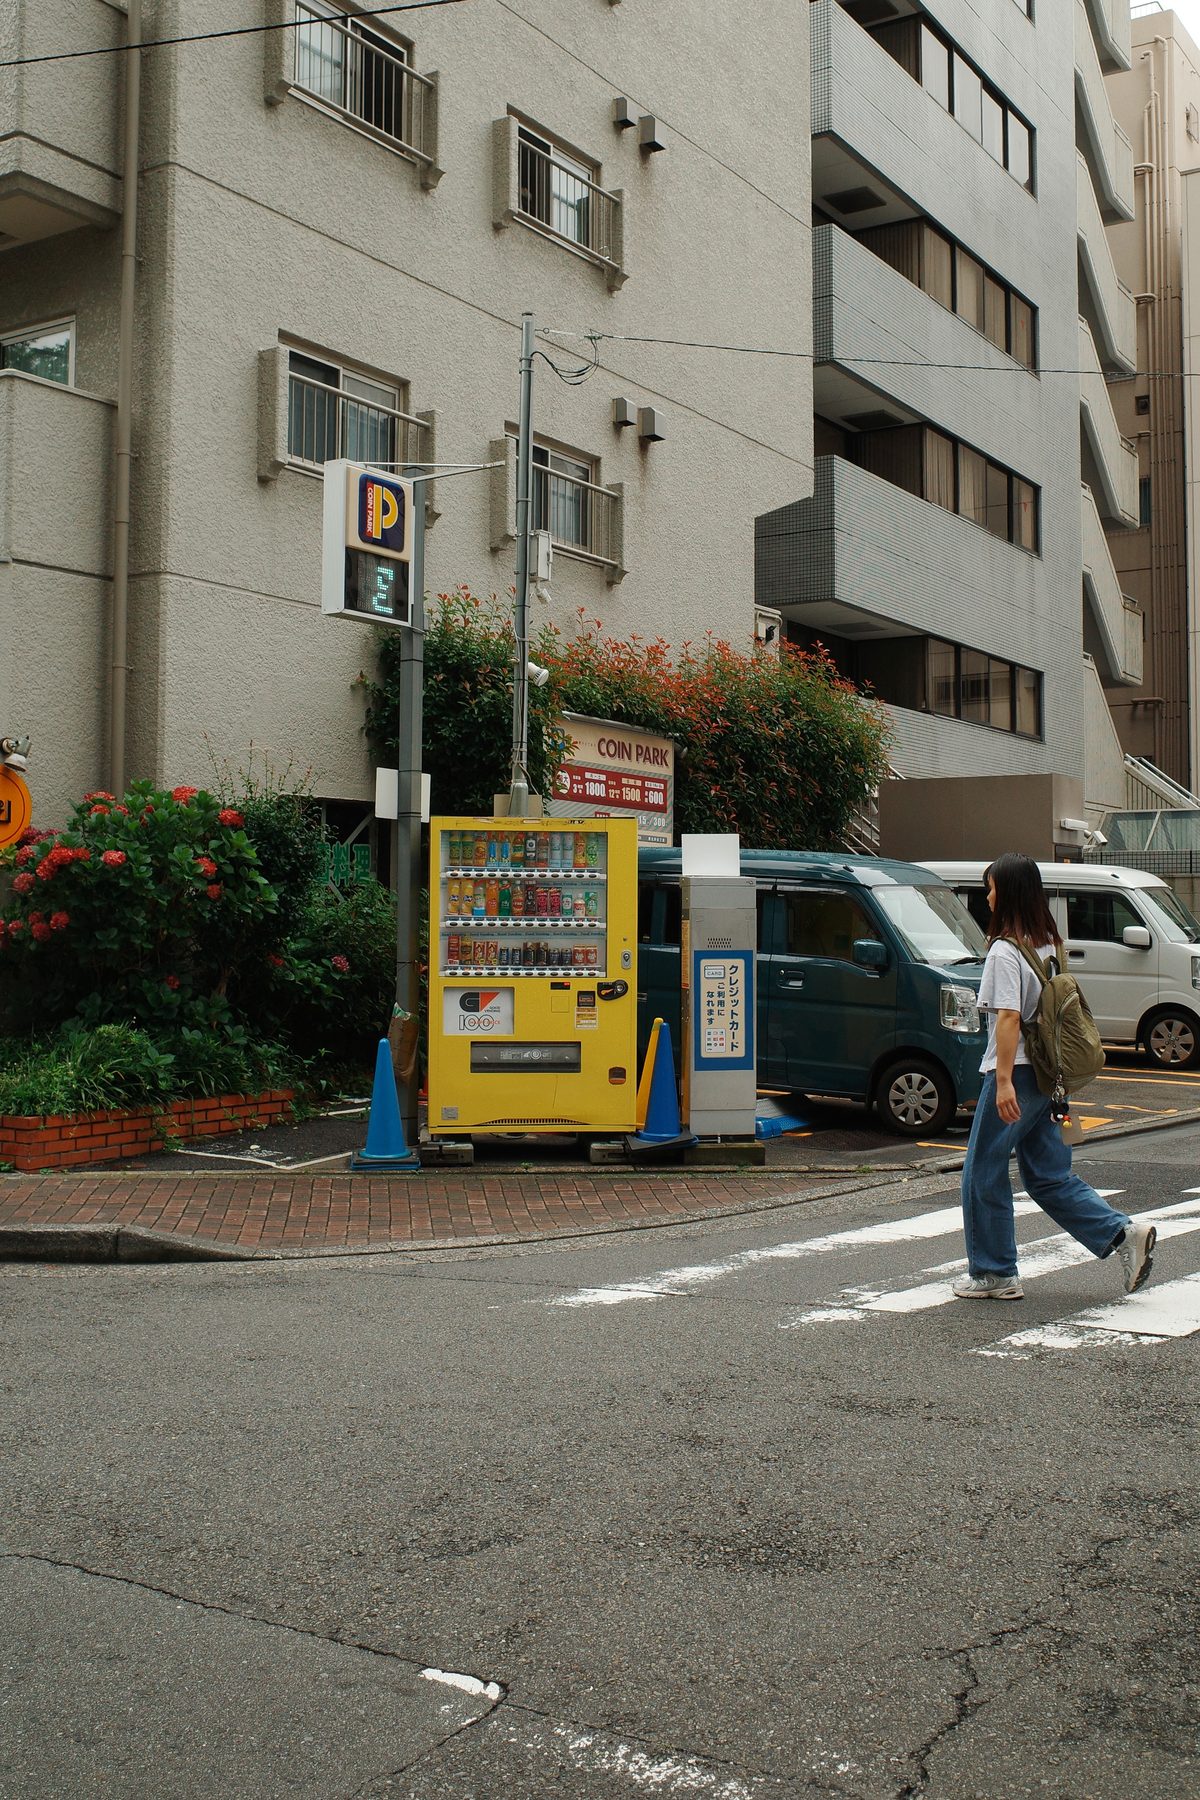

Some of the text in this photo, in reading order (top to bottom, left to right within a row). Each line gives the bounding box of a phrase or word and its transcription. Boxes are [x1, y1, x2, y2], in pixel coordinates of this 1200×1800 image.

[366, 507, 374, 533] PARK
[597, 737, 669, 767] COIN PARK
[584, 781, 606, 797] 1800
[621, 786, 641, 802] 1500
[648, 790, 664, 805] 600
[706, 991, 715, 1026] なれます
[717, 982, 726, 1017] ご利用に
[729, 965, 739, 1052] クレジットカード
[458, 1014, 495, 1031] 100
